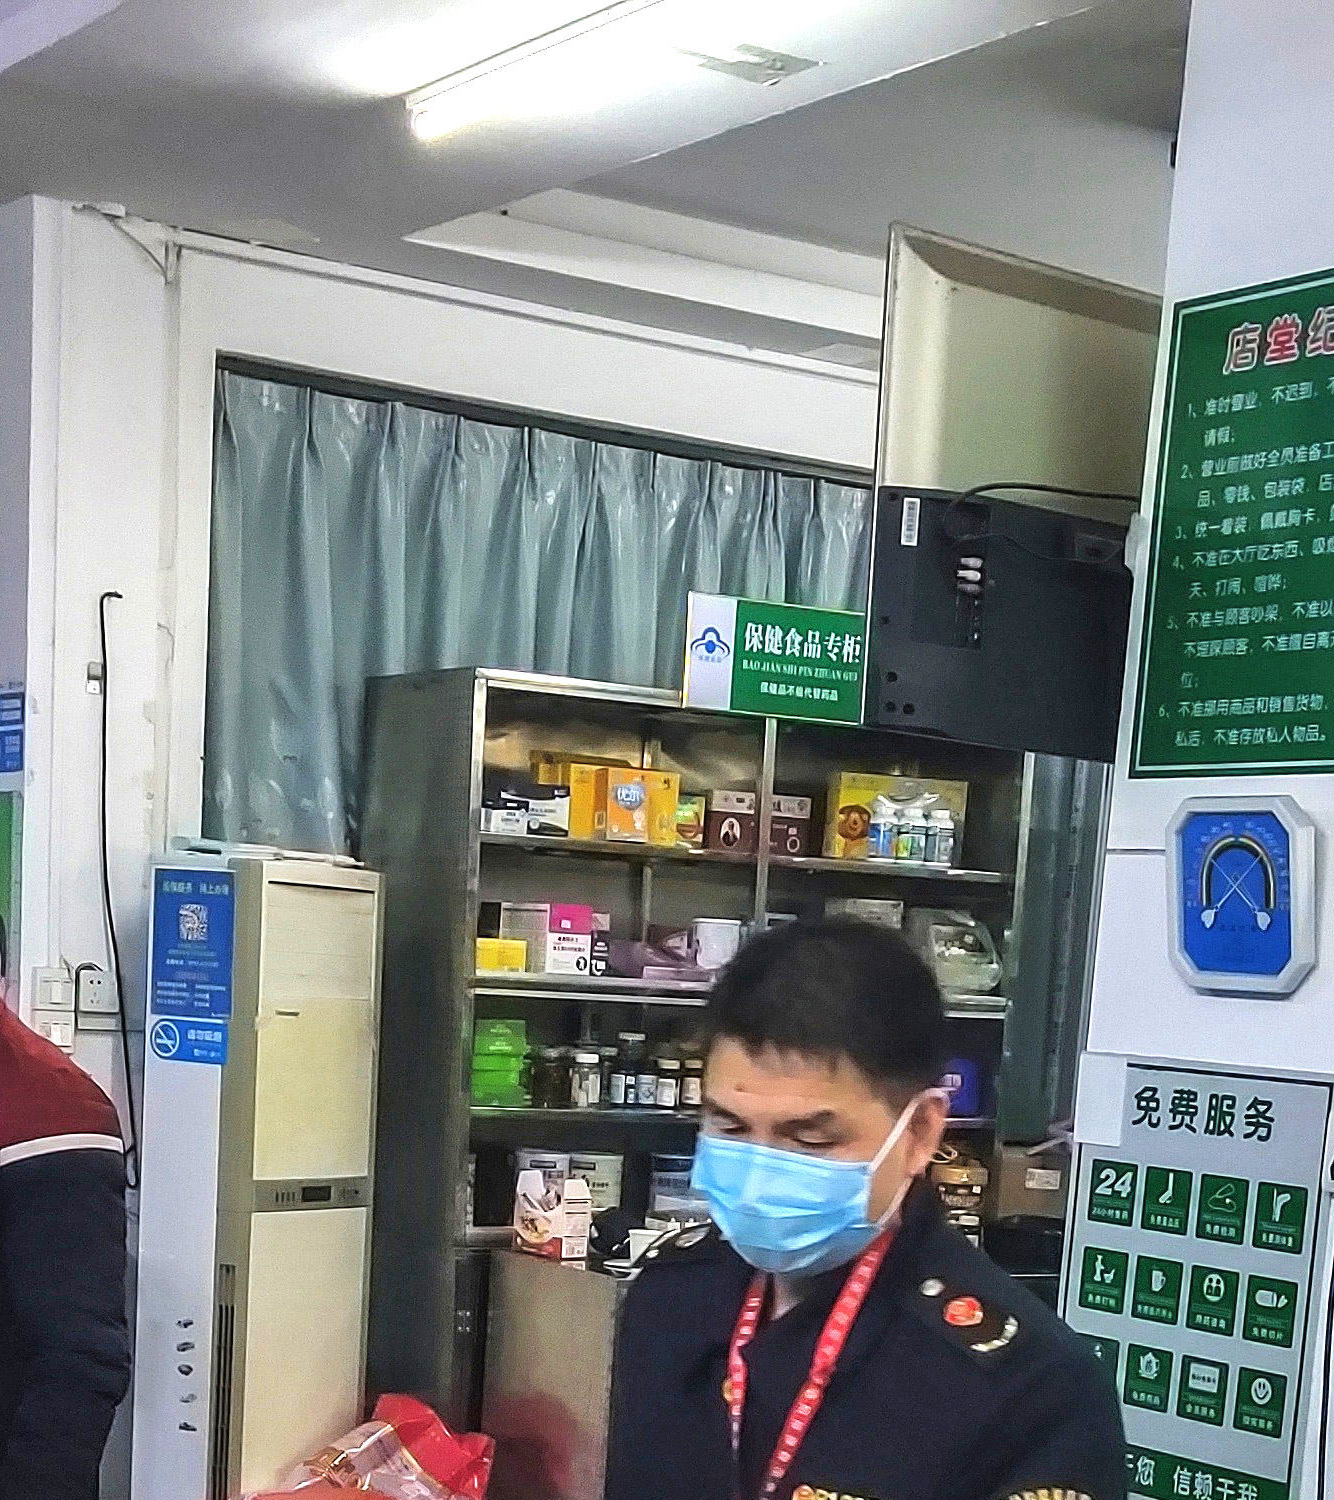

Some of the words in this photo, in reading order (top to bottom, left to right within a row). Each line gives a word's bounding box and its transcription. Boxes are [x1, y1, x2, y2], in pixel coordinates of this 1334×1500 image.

[744, 622, 861, 663] 保健食品专柜
[1131, 1085, 1276, 1143] 免费服务
[1094, 1168, 1134, 1198] 24
